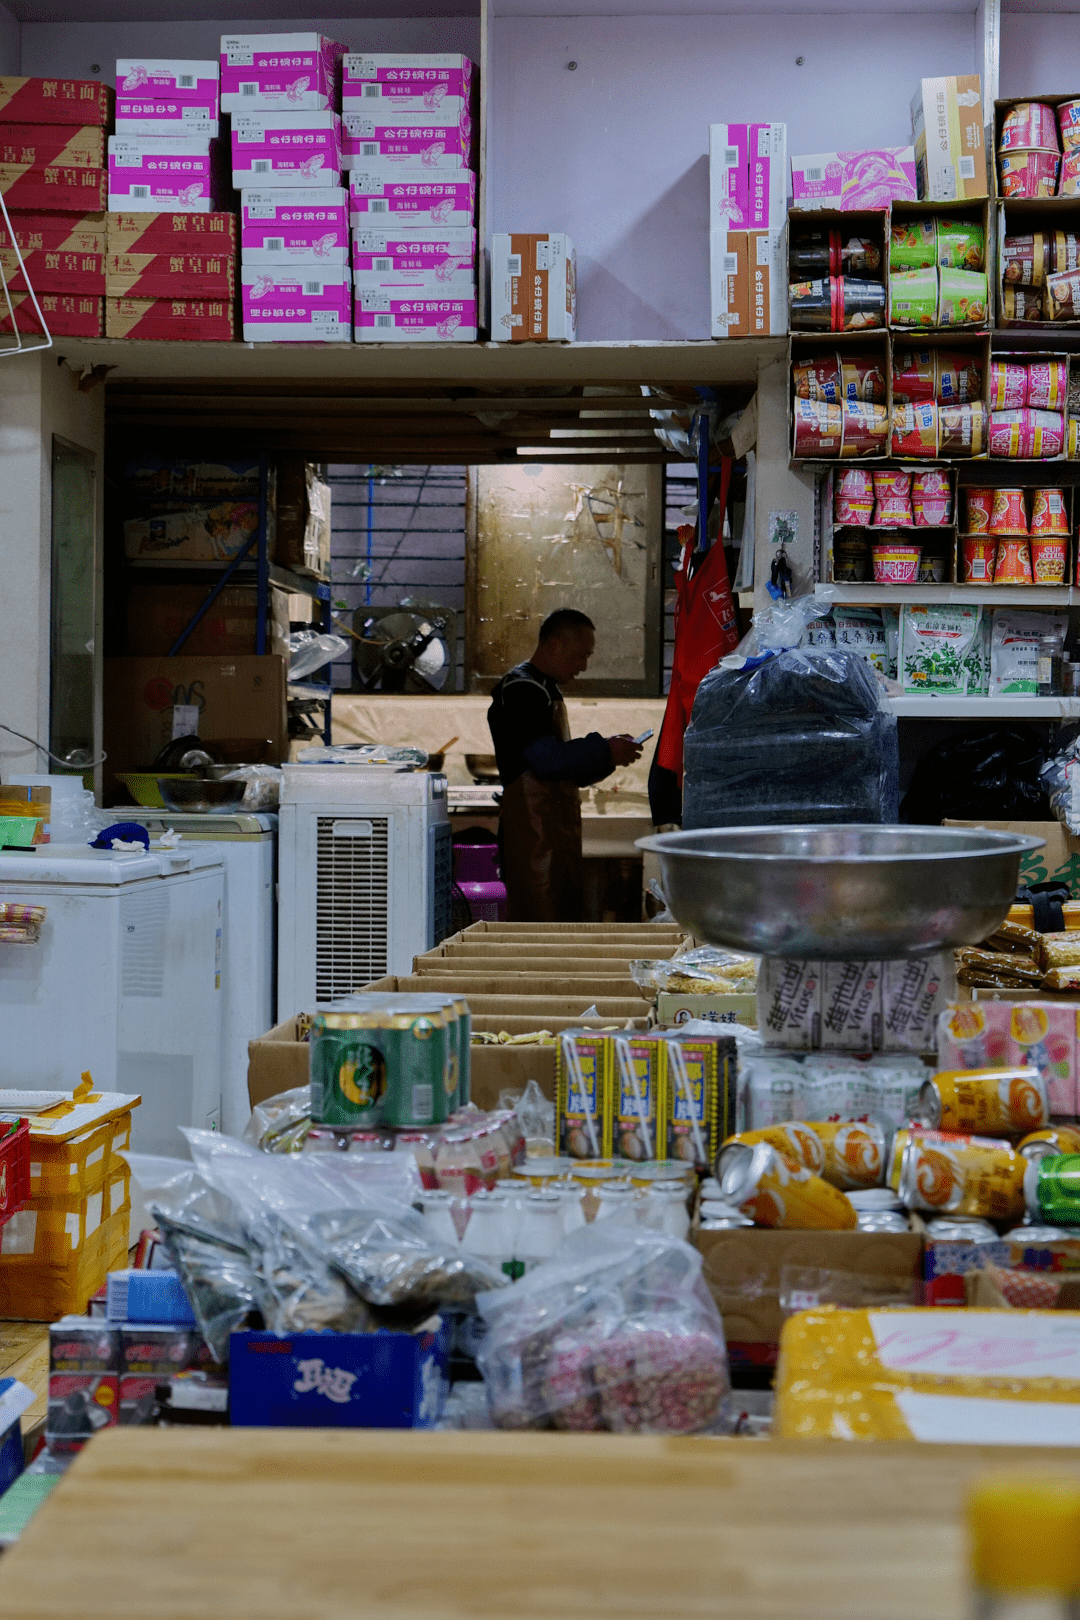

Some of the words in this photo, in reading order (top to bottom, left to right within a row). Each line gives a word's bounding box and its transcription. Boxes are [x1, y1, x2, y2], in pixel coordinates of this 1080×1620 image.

[258, 57, 313, 67] 公仔碗仔面
[386, 70, 450, 80] 公仔碗仔面
[936, 92, 948, 151] 公仔碗仔面
[384, 129, 447, 138] 公仔碗仔面
[269, 135, 326, 144] 公仔碗仔面
[387, 144, 409, 152] 海鲜味
[147, 161, 204, 170] 公仔碗仔面
[392, 185, 457, 195] 公仔碗仔面
[755, 162, 763, 222] 公仔碗仔面
[396, 202, 418, 210] 海鲜味
[281, 212, 338, 221] 公仔碗仔面
[172, 215, 224, 232] 蟹皇面
[45, 253, 96, 272] 蟹皇面
[169, 256, 221, 274] 蟹皇面
[400, 260, 423, 268] 海鲜味
[42, 295, 94, 314] 蟹皇面
[533, 275, 543, 334] 公仔碗仔面
[755, 270, 764, 330] 公仔碗仔面
[171, 301, 223, 317] 蟹皇面
[250, 308, 307, 317] 公仔碗仔面
[399, 303, 464, 312] 公仔碗仔面
